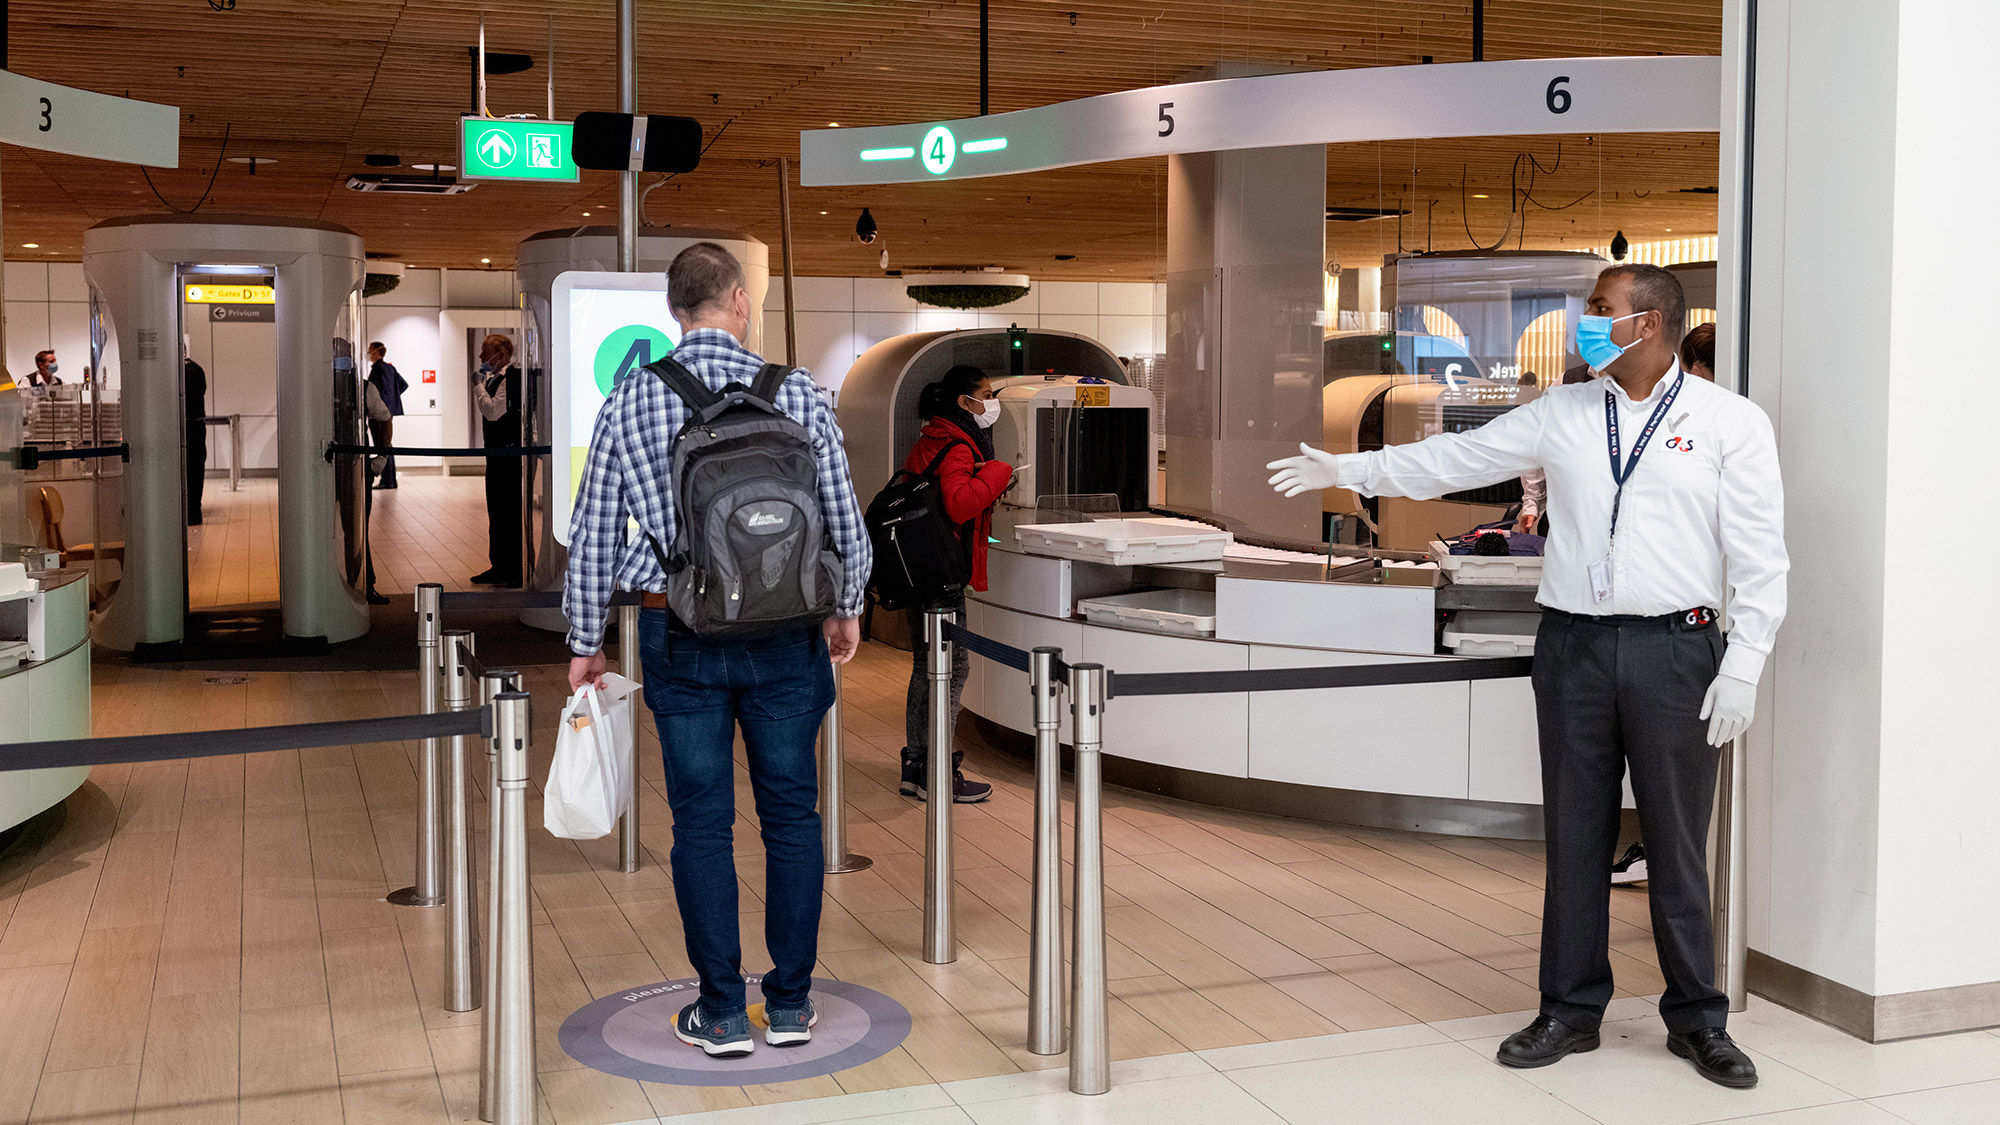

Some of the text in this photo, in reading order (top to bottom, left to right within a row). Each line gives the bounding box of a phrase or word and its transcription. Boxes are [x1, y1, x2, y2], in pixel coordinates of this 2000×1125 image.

[1546, 76, 1572, 114] 6
[39, 97, 52, 132] 3
[1158, 102, 1175, 137] 5
[930, 136, 946, 165] 4
[1331, 263, 1341, 274] 12
[218, 289, 241, 297] Gates
[243, 289, 252, 300] D
[228, 309, 260, 317] Privium
[613, 339, 651, 386] 4
[1665, 436, 1694, 452] G4S
[1685, 608, 1711, 625] G4S
[622, 983, 685, 1003] please
